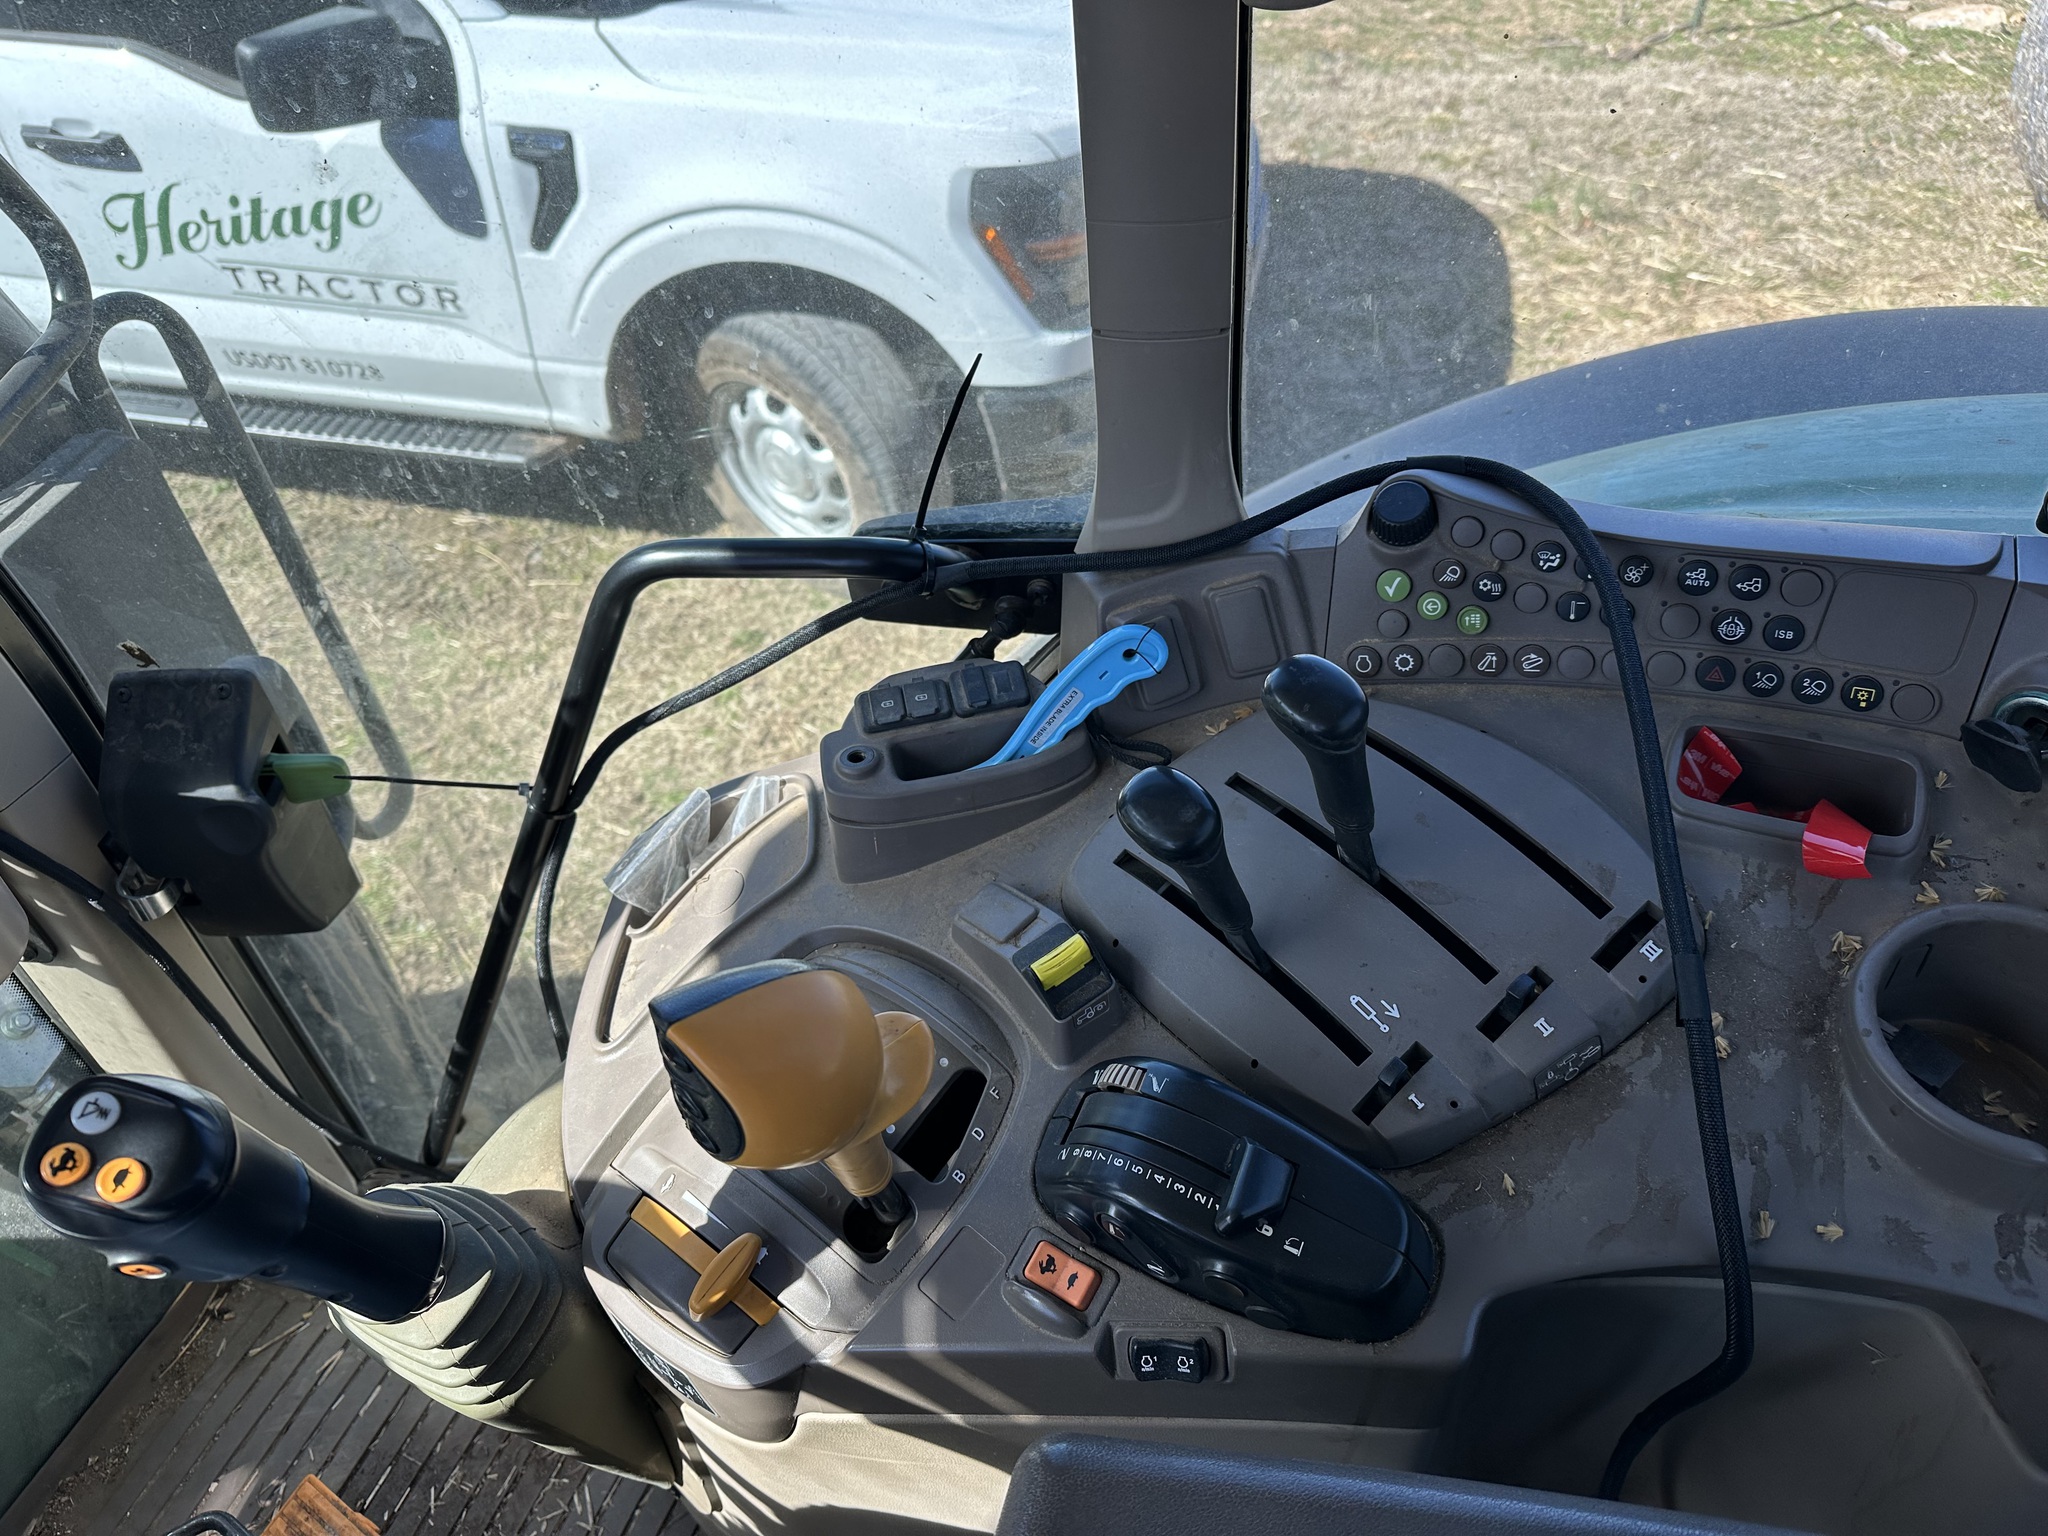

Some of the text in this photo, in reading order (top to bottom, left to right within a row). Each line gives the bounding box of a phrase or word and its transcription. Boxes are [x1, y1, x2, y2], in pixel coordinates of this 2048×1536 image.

[102, 181, 382, 270] Heritage
[221, 265, 463, 312] TRACTOR
[223, 348, 296, 373] USDOT
[1685, 578, 1710, 587] AUTO
[1774, 629, 1794, 640] ISB
[1755, 671, 1761, 679] 1
[1802, 678, 1811, 687] 2
[1030, 690, 1079, 744] EXTRA BLADE INSIDE
[989, 1086, 1000, 1100] F
[971, 1127, 985, 1141] D
[1072, 1148, 1081, 1156] 9
[1084, 1149, 1093, 1158] 8
[1096, 1152, 1106, 1161] 7
[1113, 1157, 1124, 1167] 6
[1131, 1164, 1144, 1175] 5
[951, 1169, 966, 1184] B
[1153, 1173, 1166, 1184] 4
[1173, 1182, 1186, 1194] 3
[1194, 1192, 1207, 1205] 2
